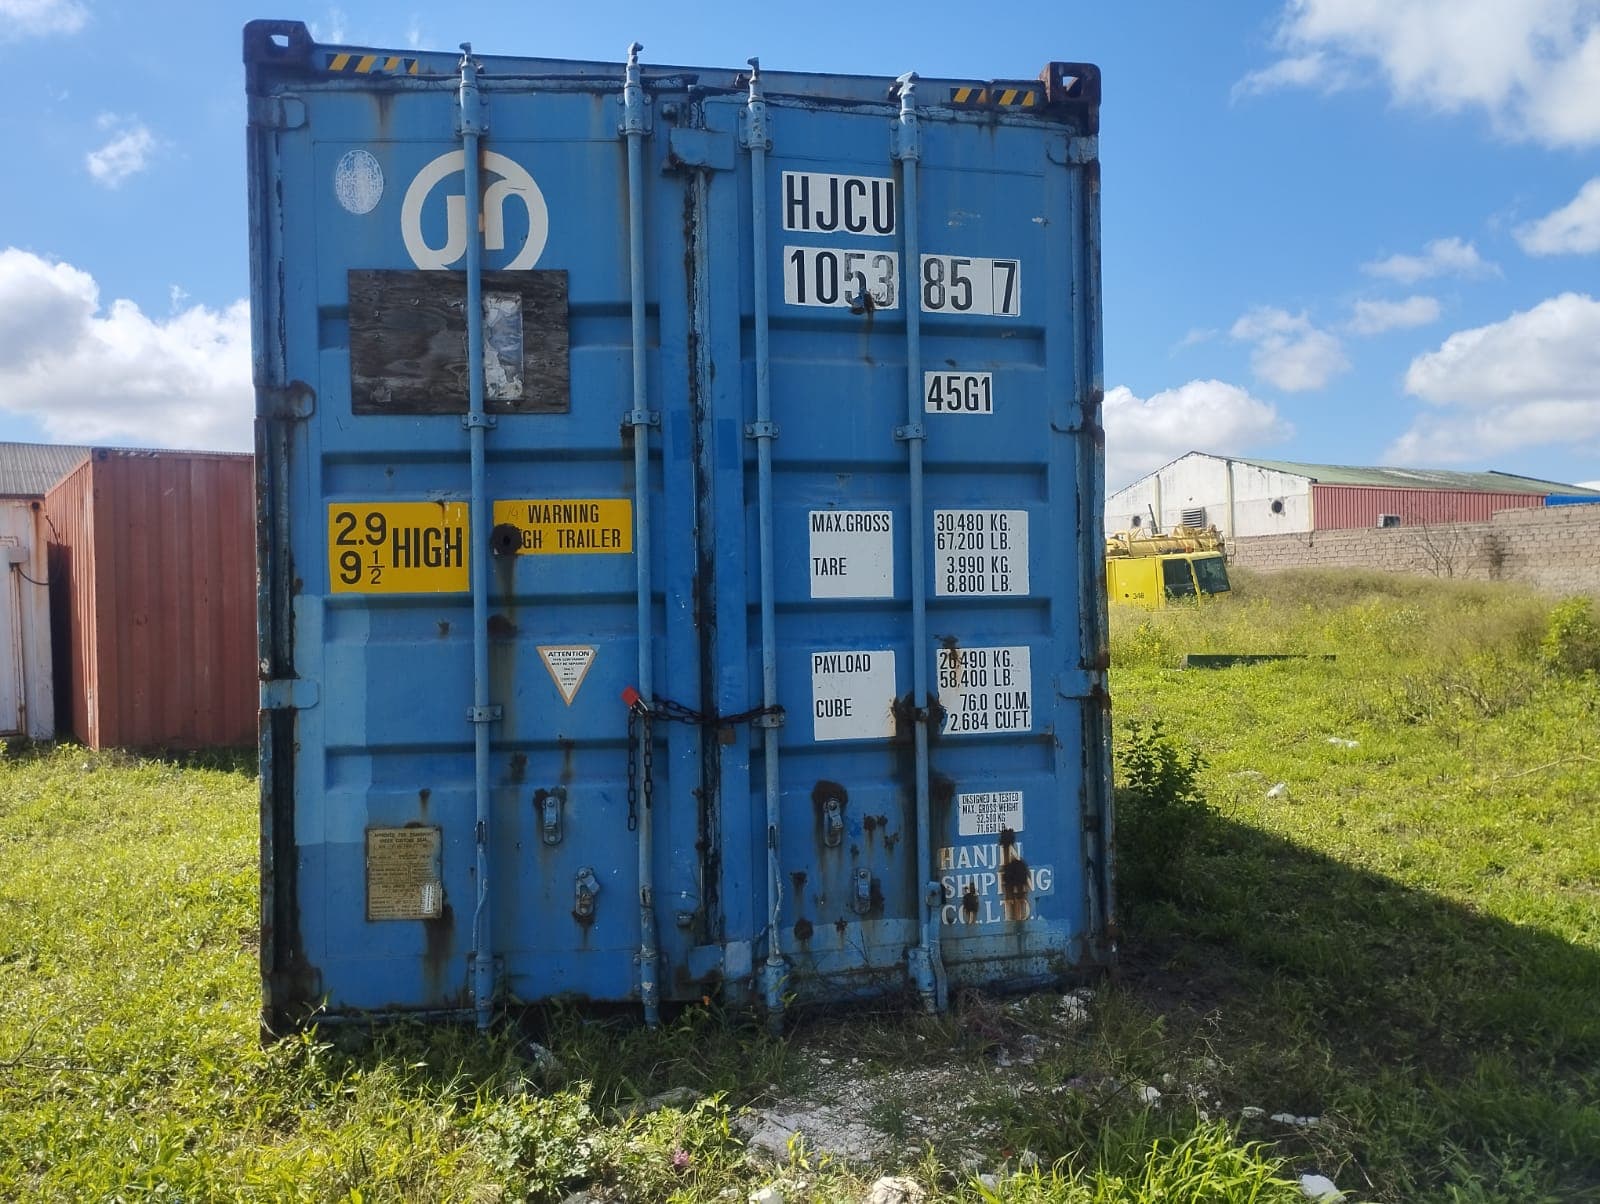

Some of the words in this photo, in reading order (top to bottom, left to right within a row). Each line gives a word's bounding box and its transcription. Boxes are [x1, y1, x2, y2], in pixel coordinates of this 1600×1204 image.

[786, 174, 895, 234] HJCU
[791, 249, 895, 308] 1053
[923, 257, 973, 311] 85
[993, 261, 1017, 314] 7
[927, 375, 991, 412] 45G1
[528, 503, 600, 524] WARNING
[811, 513, 890, 533] MAX.GROSS
[936, 513, 984, 532] 30,480
[990, 513, 1011, 532] KG.
[335, 511, 387, 546] 2.9
[557, 528, 621, 548] TRAILER
[392, 527, 463, 569] HIGH
[937, 532, 984, 550] 67,200
[991, 532, 1011, 550] LB.
[812, 557, 848, 577] TARE
[946, 556, 985, 574] 3,990
[991, 555, 1012, 574] KG.
[947, 574, 985, 593] 8,800
[991, 574, 1012, 592] LB.
[814, 654, 871, 674] PAYLOAD
[993, 650, 1014, 668] KG.
[940, 669, 987, 689] 58,400
[994, 669, 1015, 687] LB.
[815, 699, 853, 718] CUBE
[959, 693, 988, 712] 76.0
[994, 691, 1031, 710] CU.M.
[950, 712, 989, 732] 2,684
[995, 710, 1032, 729] CU.FT.
[962, 794, 990, 805] DESIGNED
[999, 792, 1019, 802] TESTED
[978, 803, 997, 814] GROSS
[998, 802, 1019, 812] WEIGHT
[941, 868, 1052, 899] SHIPNG
